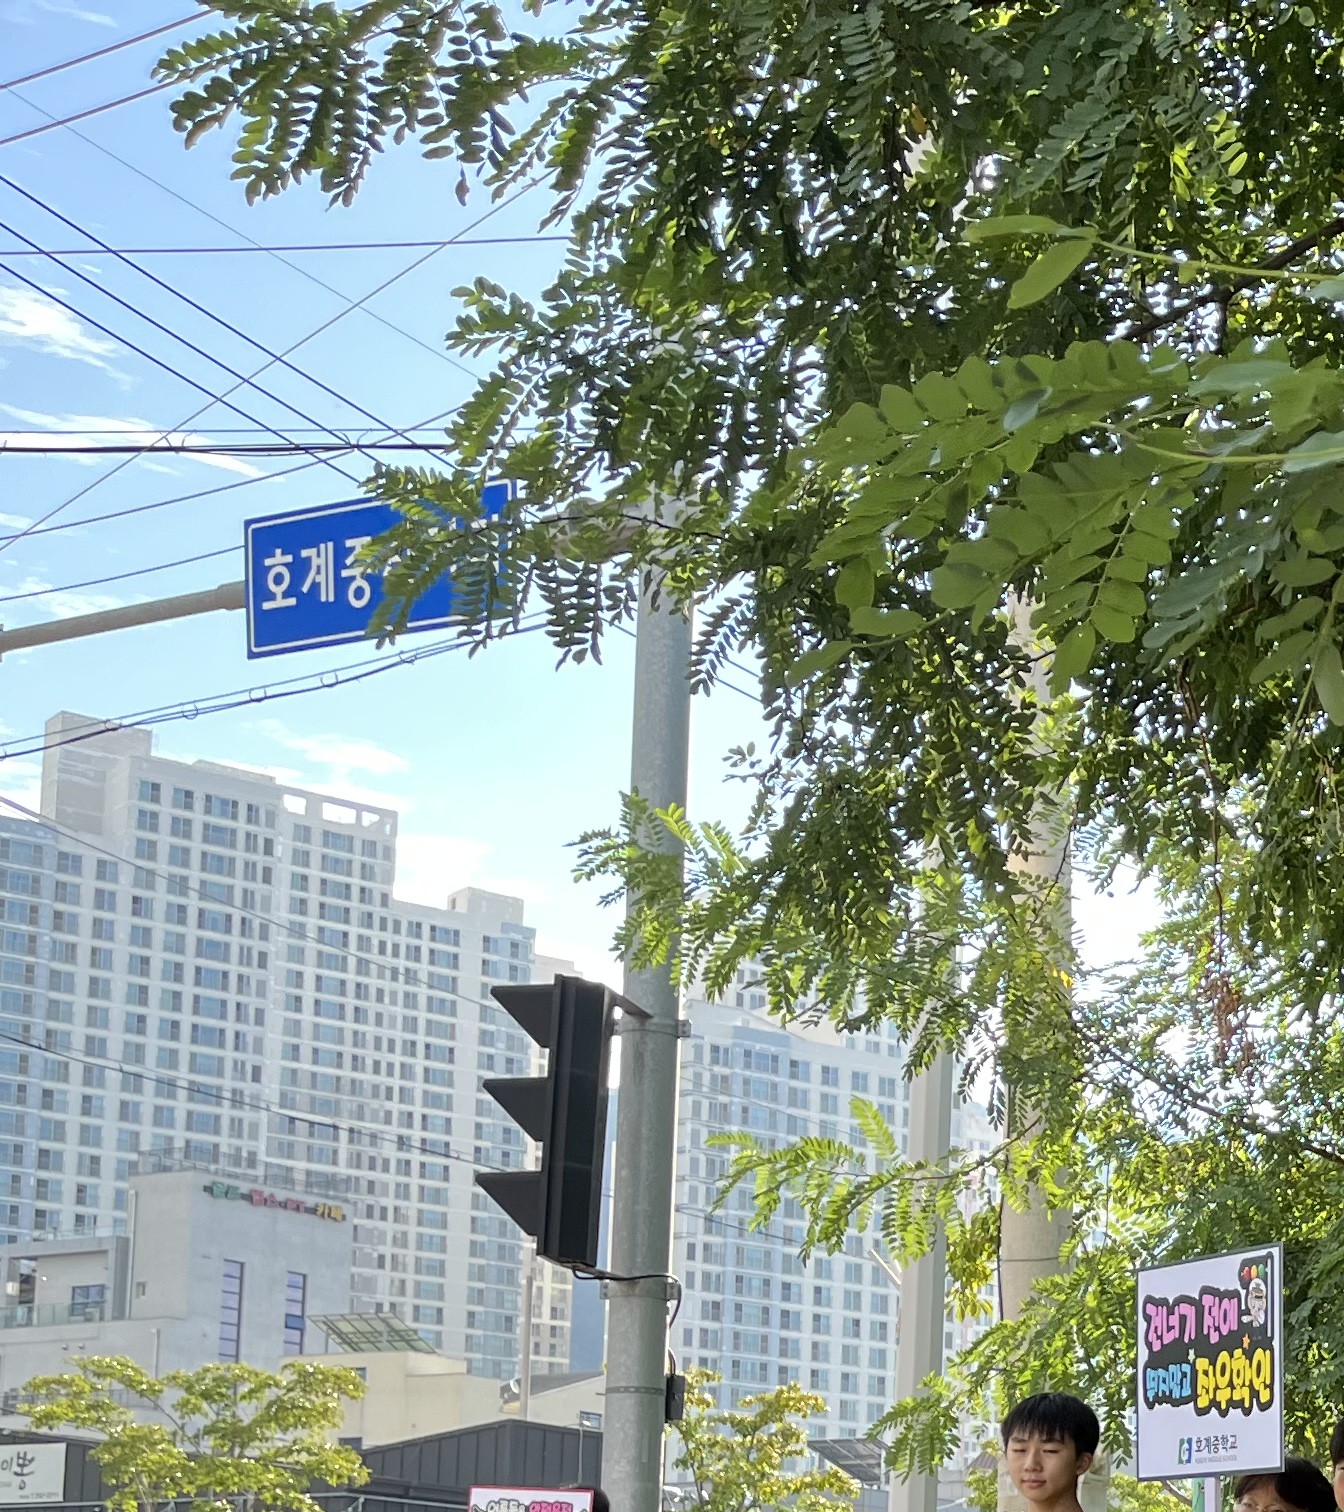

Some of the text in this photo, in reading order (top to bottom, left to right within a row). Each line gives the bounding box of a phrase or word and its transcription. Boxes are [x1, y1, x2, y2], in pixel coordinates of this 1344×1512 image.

[1145, 1294, 1238, 1352] 건너기 전에
[1195, 1347, 1271, 1409] 좌우확인
[1194, 1433, 1238, 1455] 호계중학교
